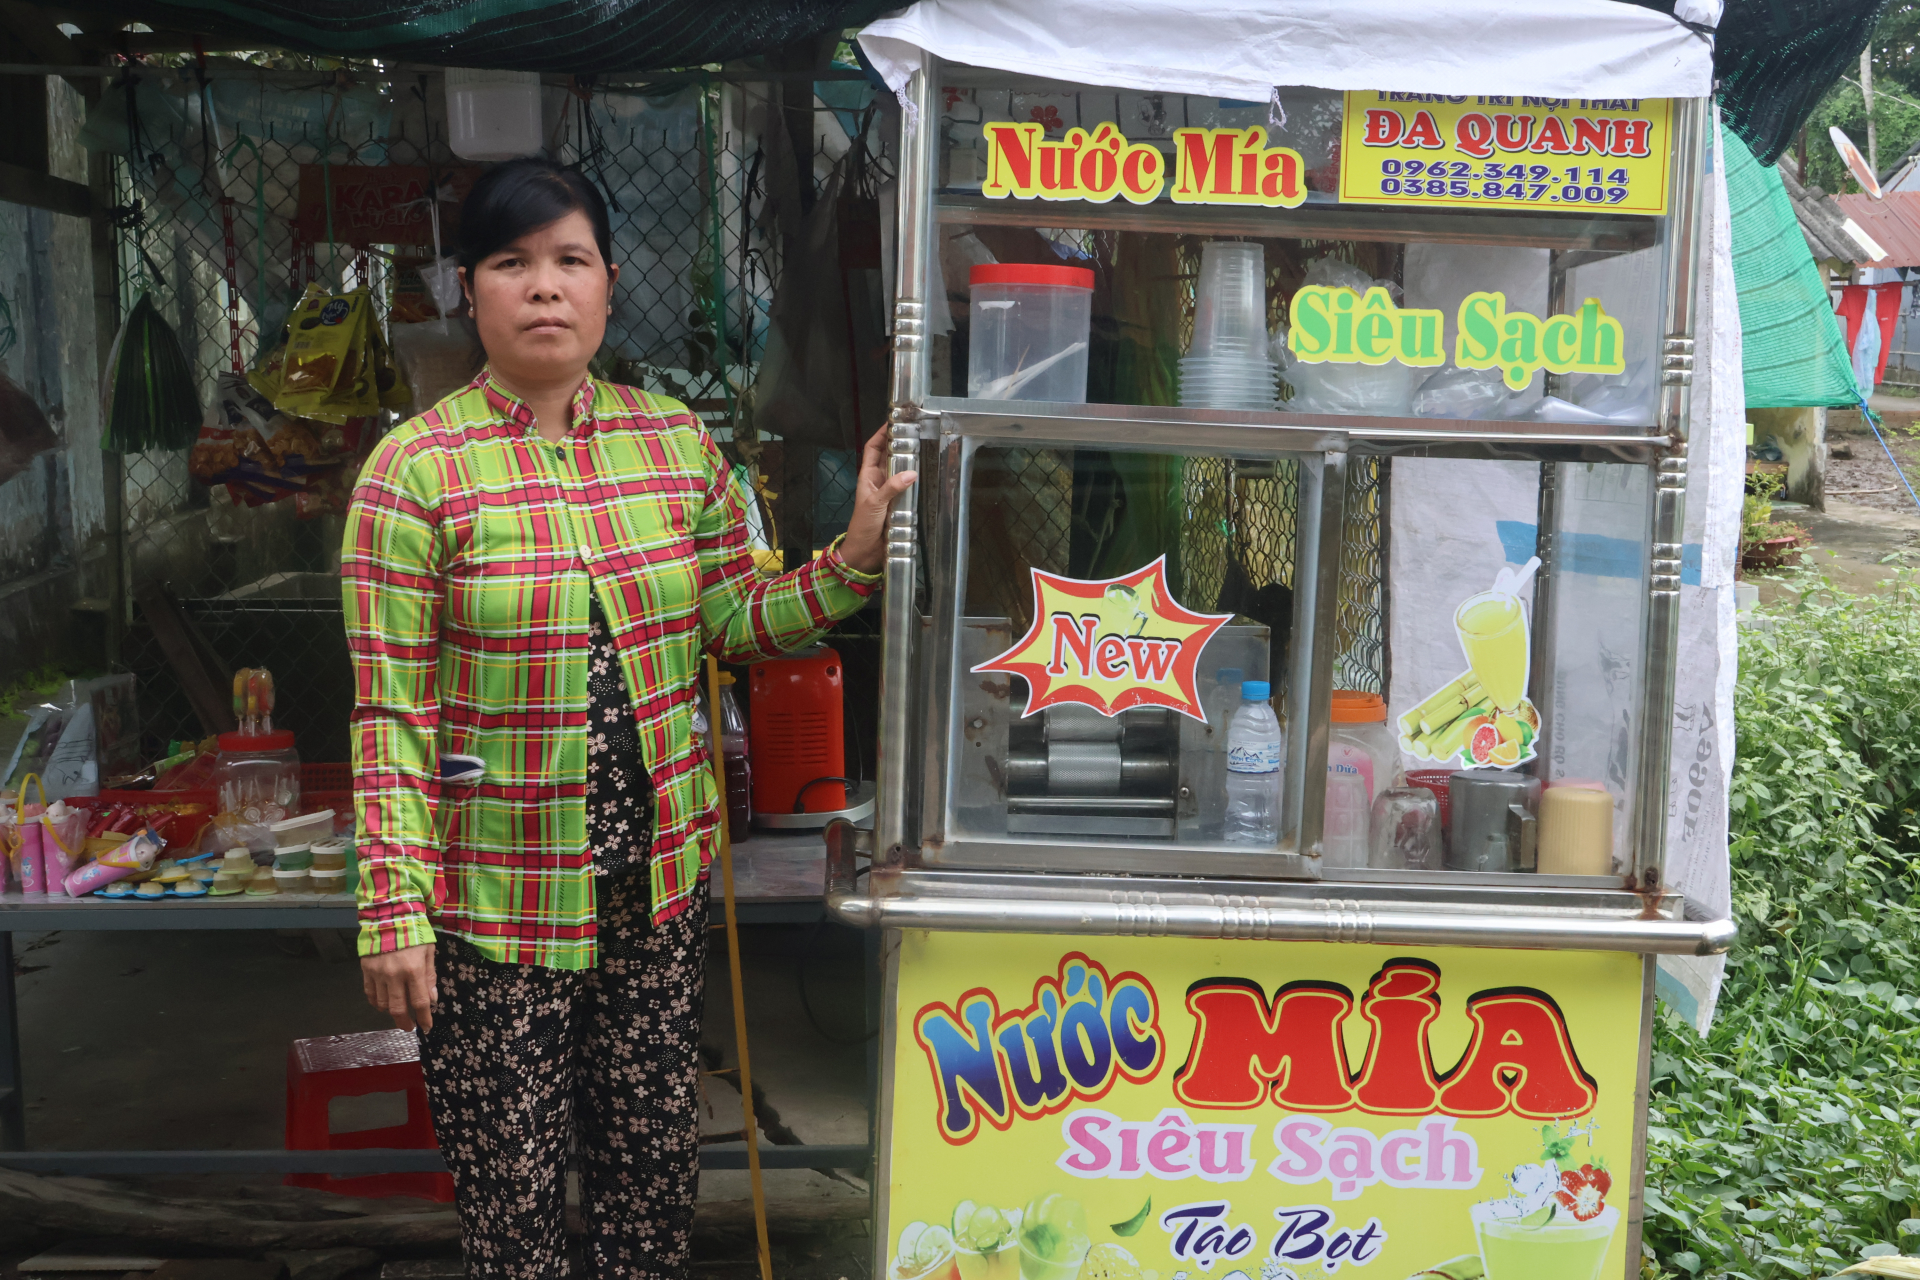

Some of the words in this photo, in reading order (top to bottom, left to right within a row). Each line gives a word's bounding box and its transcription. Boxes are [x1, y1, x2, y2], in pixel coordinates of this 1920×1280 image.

[986, 123, 1159, 197] Nước
[1177, 130, 1301, 199] Mía
[1361, 108, 1446, 149] ĐA
[1454, 111, 1652, 159] QUANH
[1379, 177, 1630, 205] 0385.847.009
[1380, 158, 1630, 186] 0962.349.114
[1292, 288, 1440, 360] Siêu
[1459, 296, 1620, 384] Sạch
[1045, 611, 1183, 684] New
[916, 953, 1163, 1142] Nước
[1173, 957, 1598, 1120] MÍA
[1274, 1117, 1482, 1193] Sạch
[1162, 1204, 1253, 1267] Tạo
[1272, 1205, 1386, 1265] Bọt
